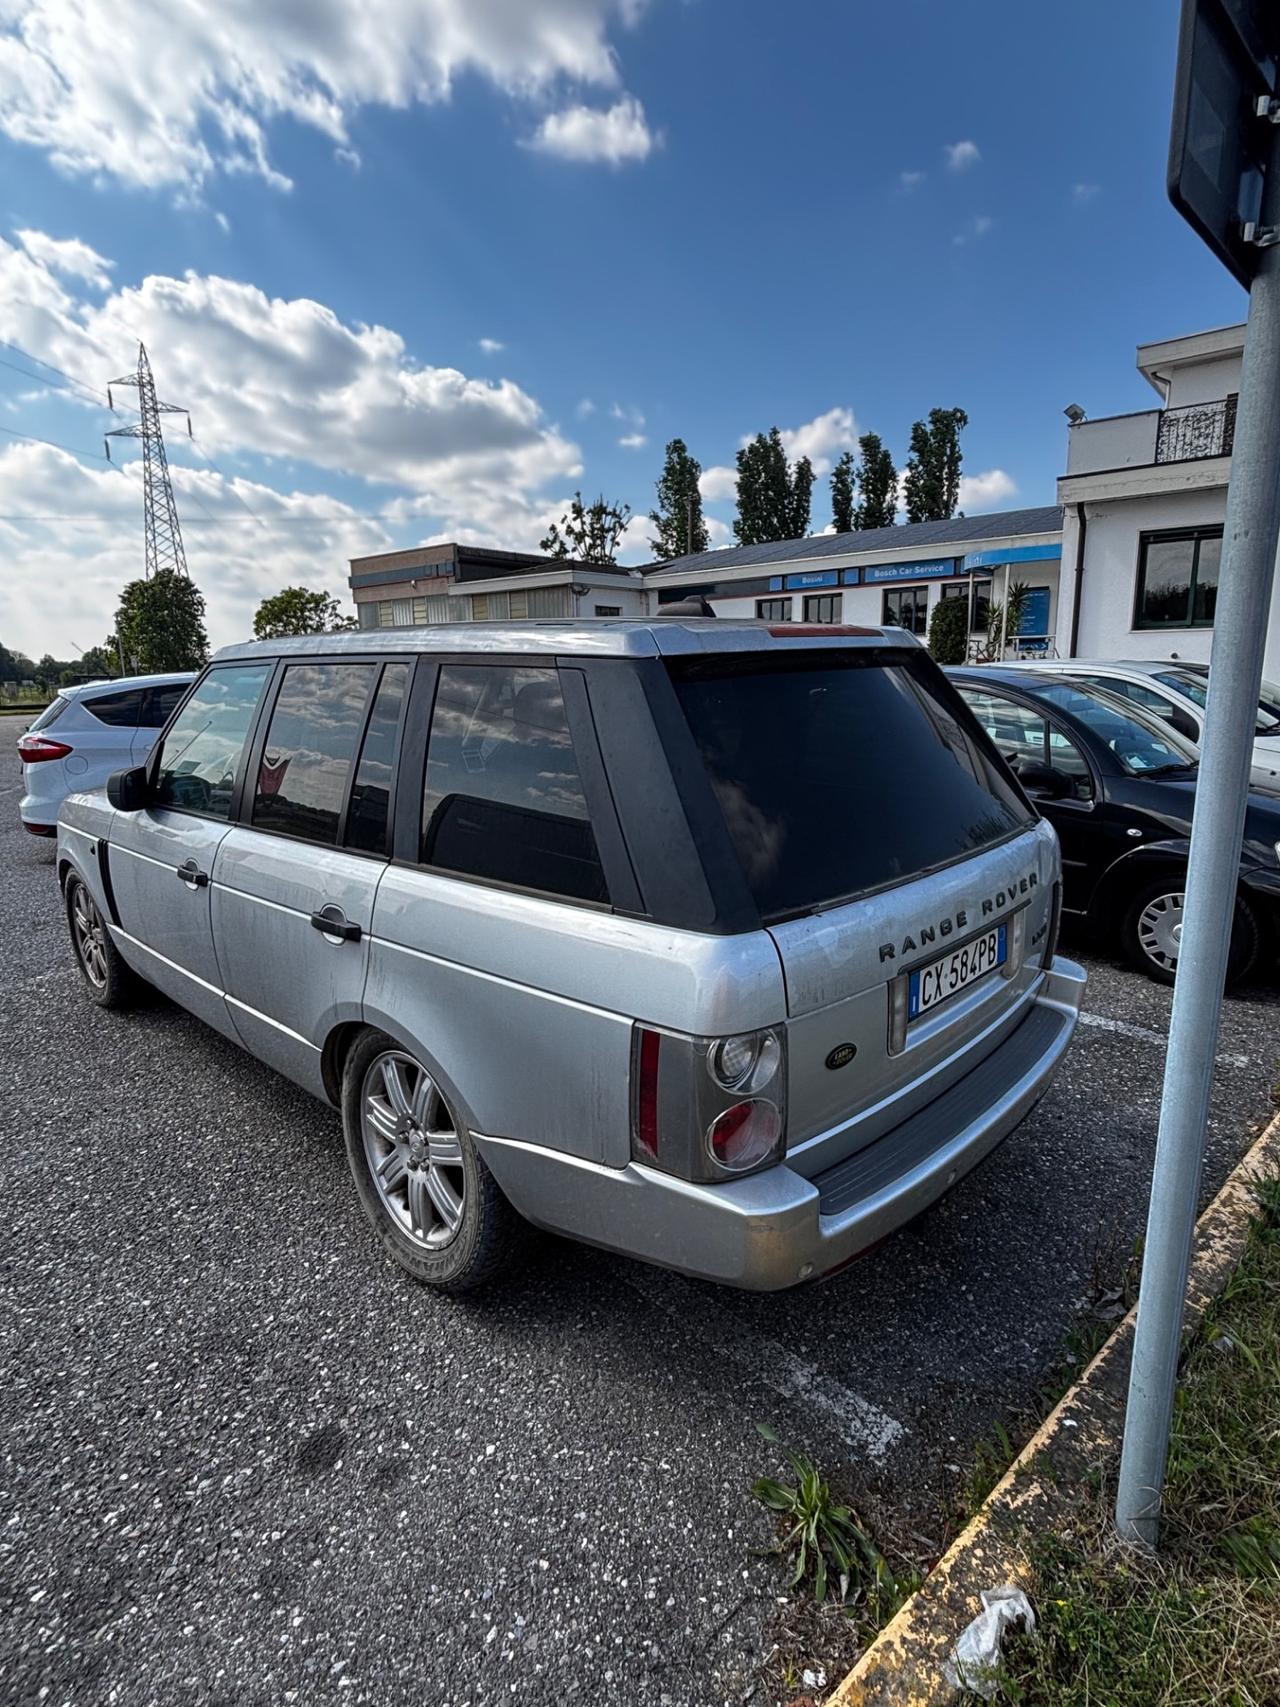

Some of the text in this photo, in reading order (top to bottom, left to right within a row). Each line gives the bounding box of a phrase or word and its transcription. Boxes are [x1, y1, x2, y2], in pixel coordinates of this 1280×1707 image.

[874, 565, 944, 577] Bosch Car Service
[878, 872, 1038, 963] RANGE ROVER
[922, 962, 944, 1006] CX
